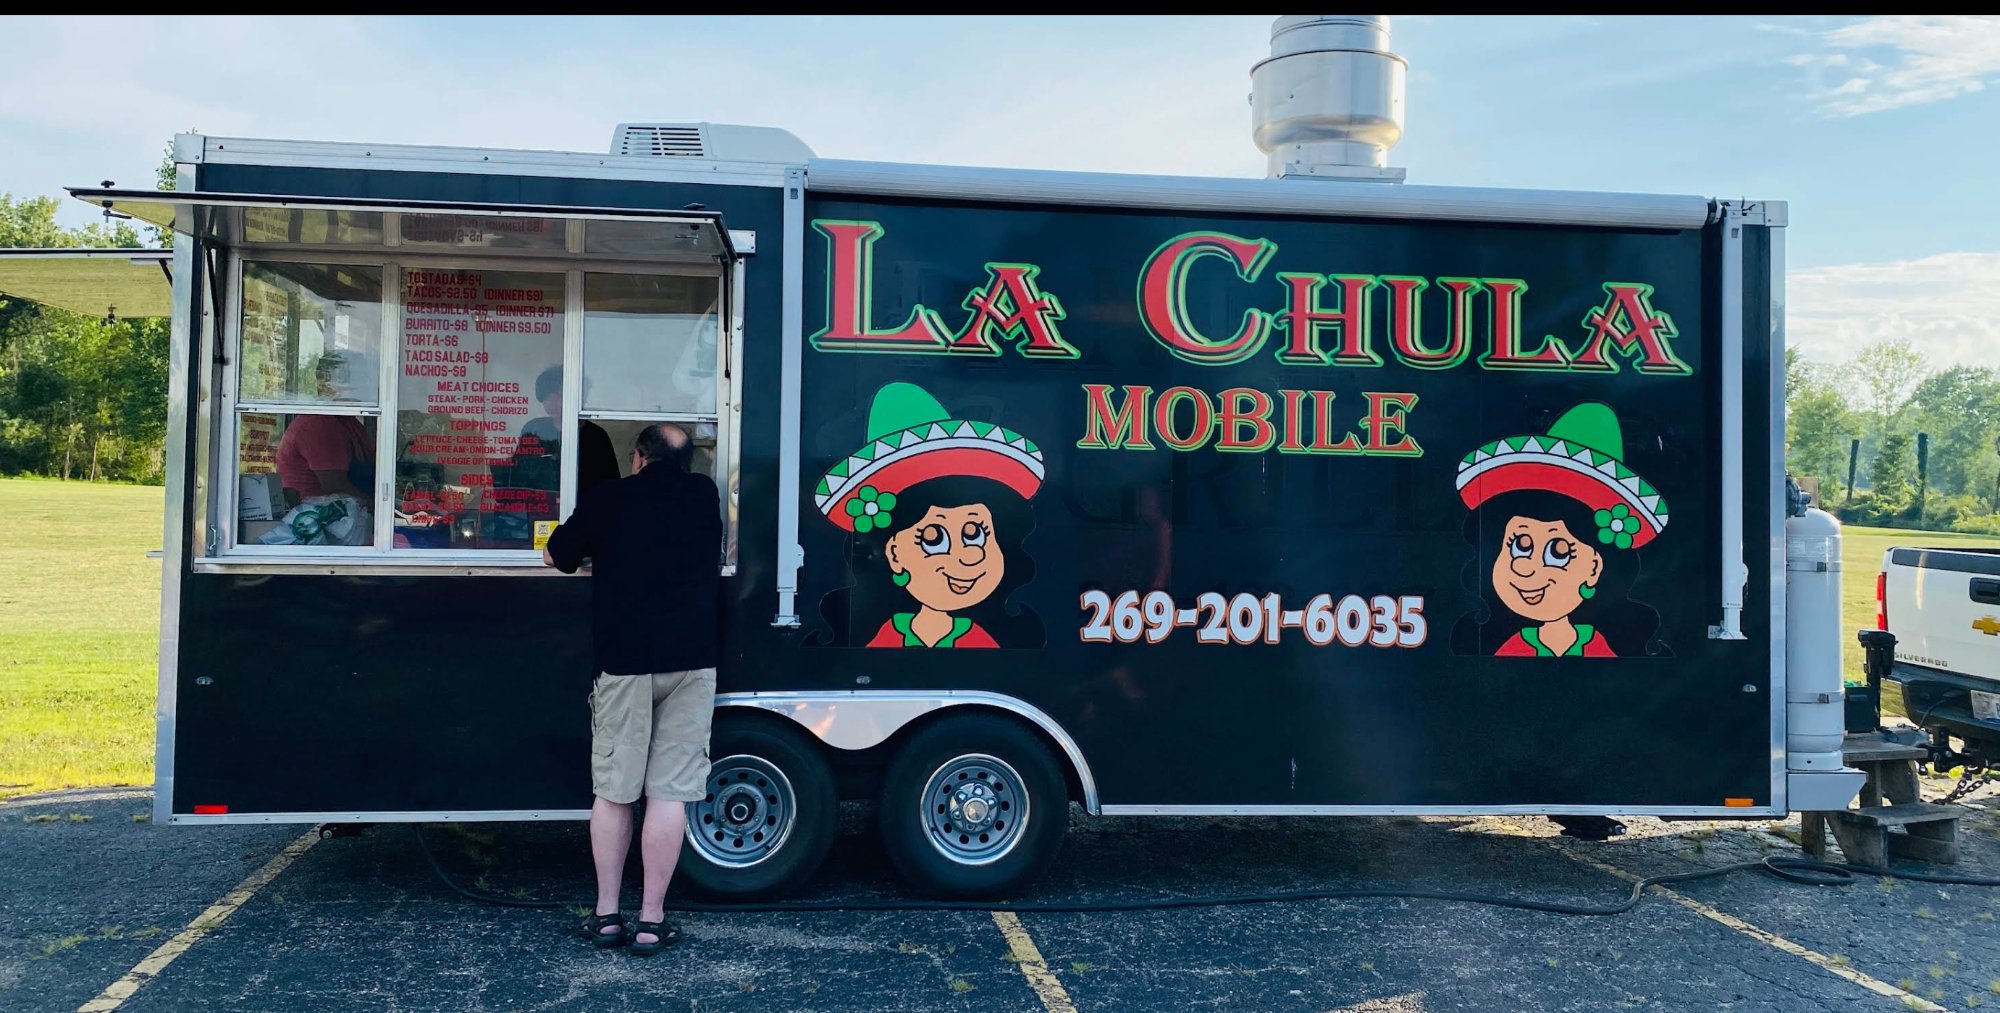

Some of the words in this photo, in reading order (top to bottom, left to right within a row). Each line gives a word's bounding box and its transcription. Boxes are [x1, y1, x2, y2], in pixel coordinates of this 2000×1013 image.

[809, 219, 1081, 359] LA
[1136, 230, 1693, 376] CHULA
[405, 350, 433, 362] TACO
[437, 381, 469, 392] MEAT
[471, 382, 520, 393] CHOICES
[427, 405, 463, 414] GROUND
[450, 420, 506, 431] TOPPINGS
[1076, 383, 1424, 457] MOBILE
[460, 474, 493, 486] SIDES
[1080, 590, 1428, 649] 269-201-6035
